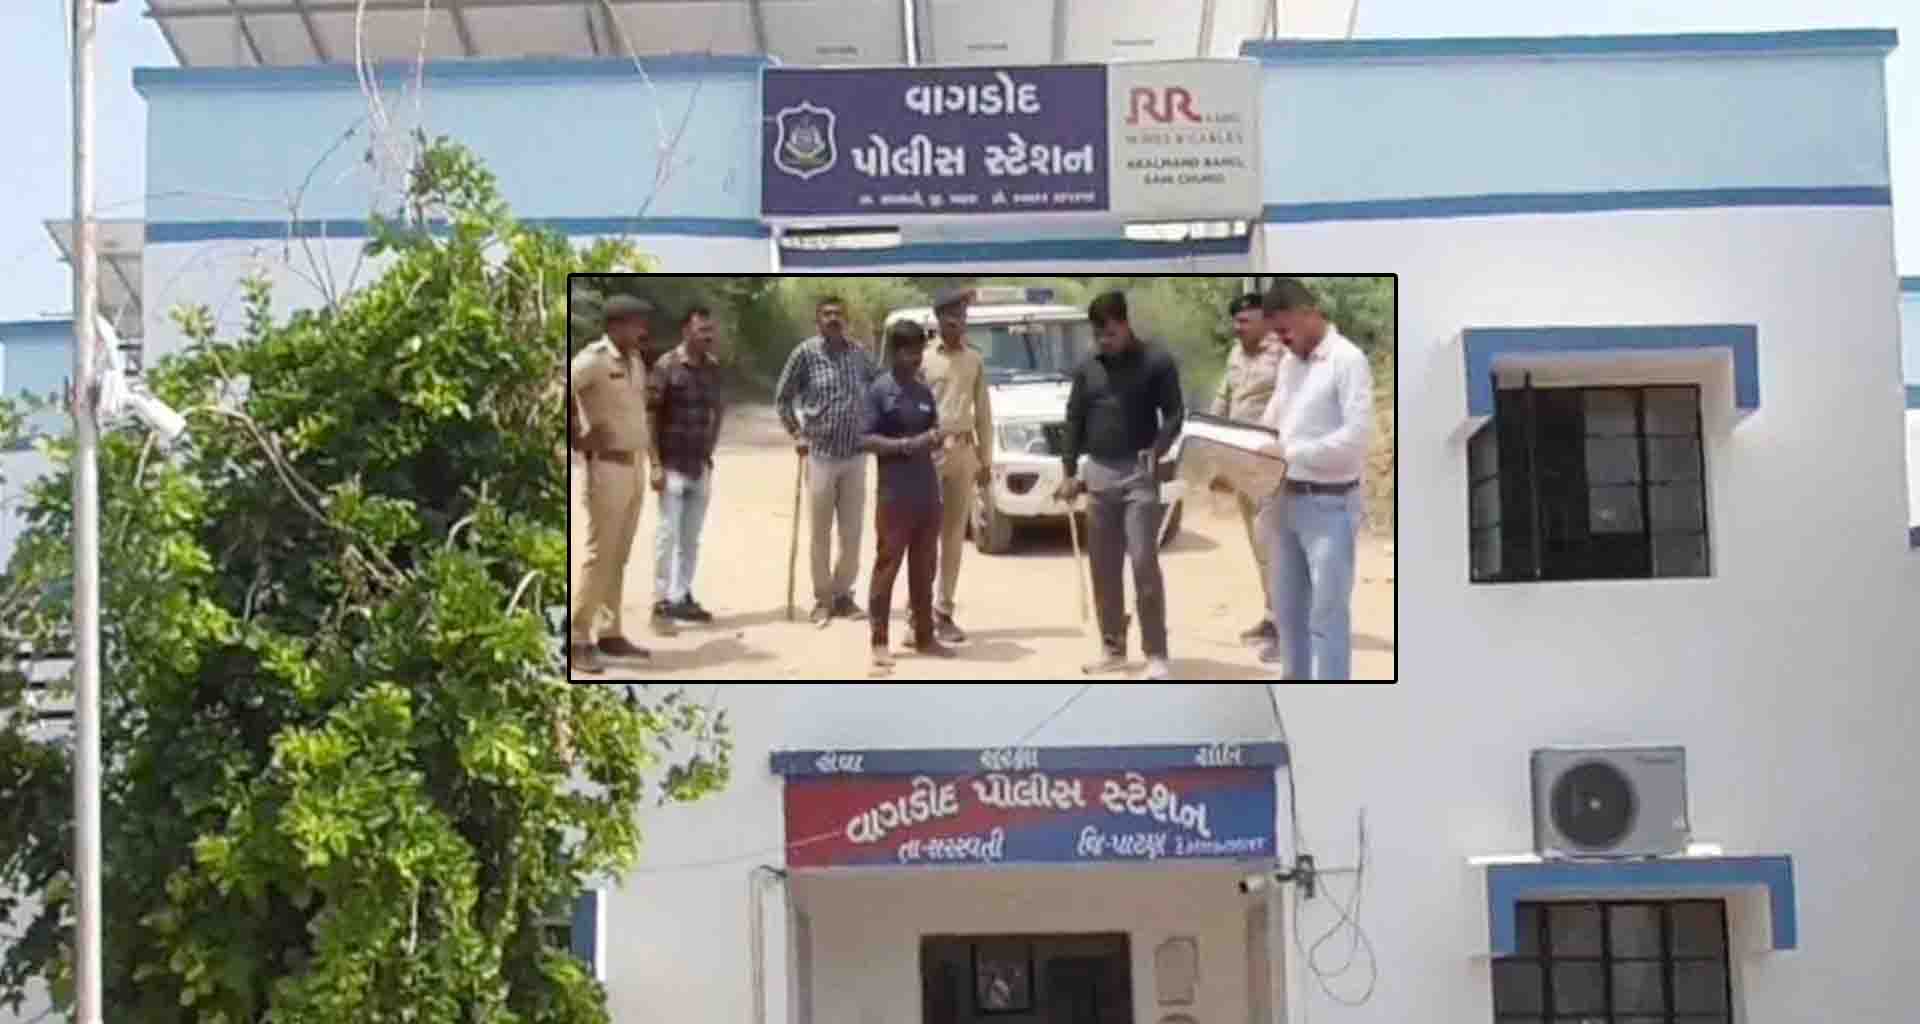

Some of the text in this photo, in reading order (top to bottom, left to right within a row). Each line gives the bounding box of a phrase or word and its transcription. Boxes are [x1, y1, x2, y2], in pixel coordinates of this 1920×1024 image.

[905, 72, 1041, 116] વાગડોદ
[1125, 86, 1201, 124] RR
[852, 134, 1095, 177] પોલીસ સ્ટેશન
[846, 772, 1211, 844] વાગડોદ પોલીસ સ્ટેશન
